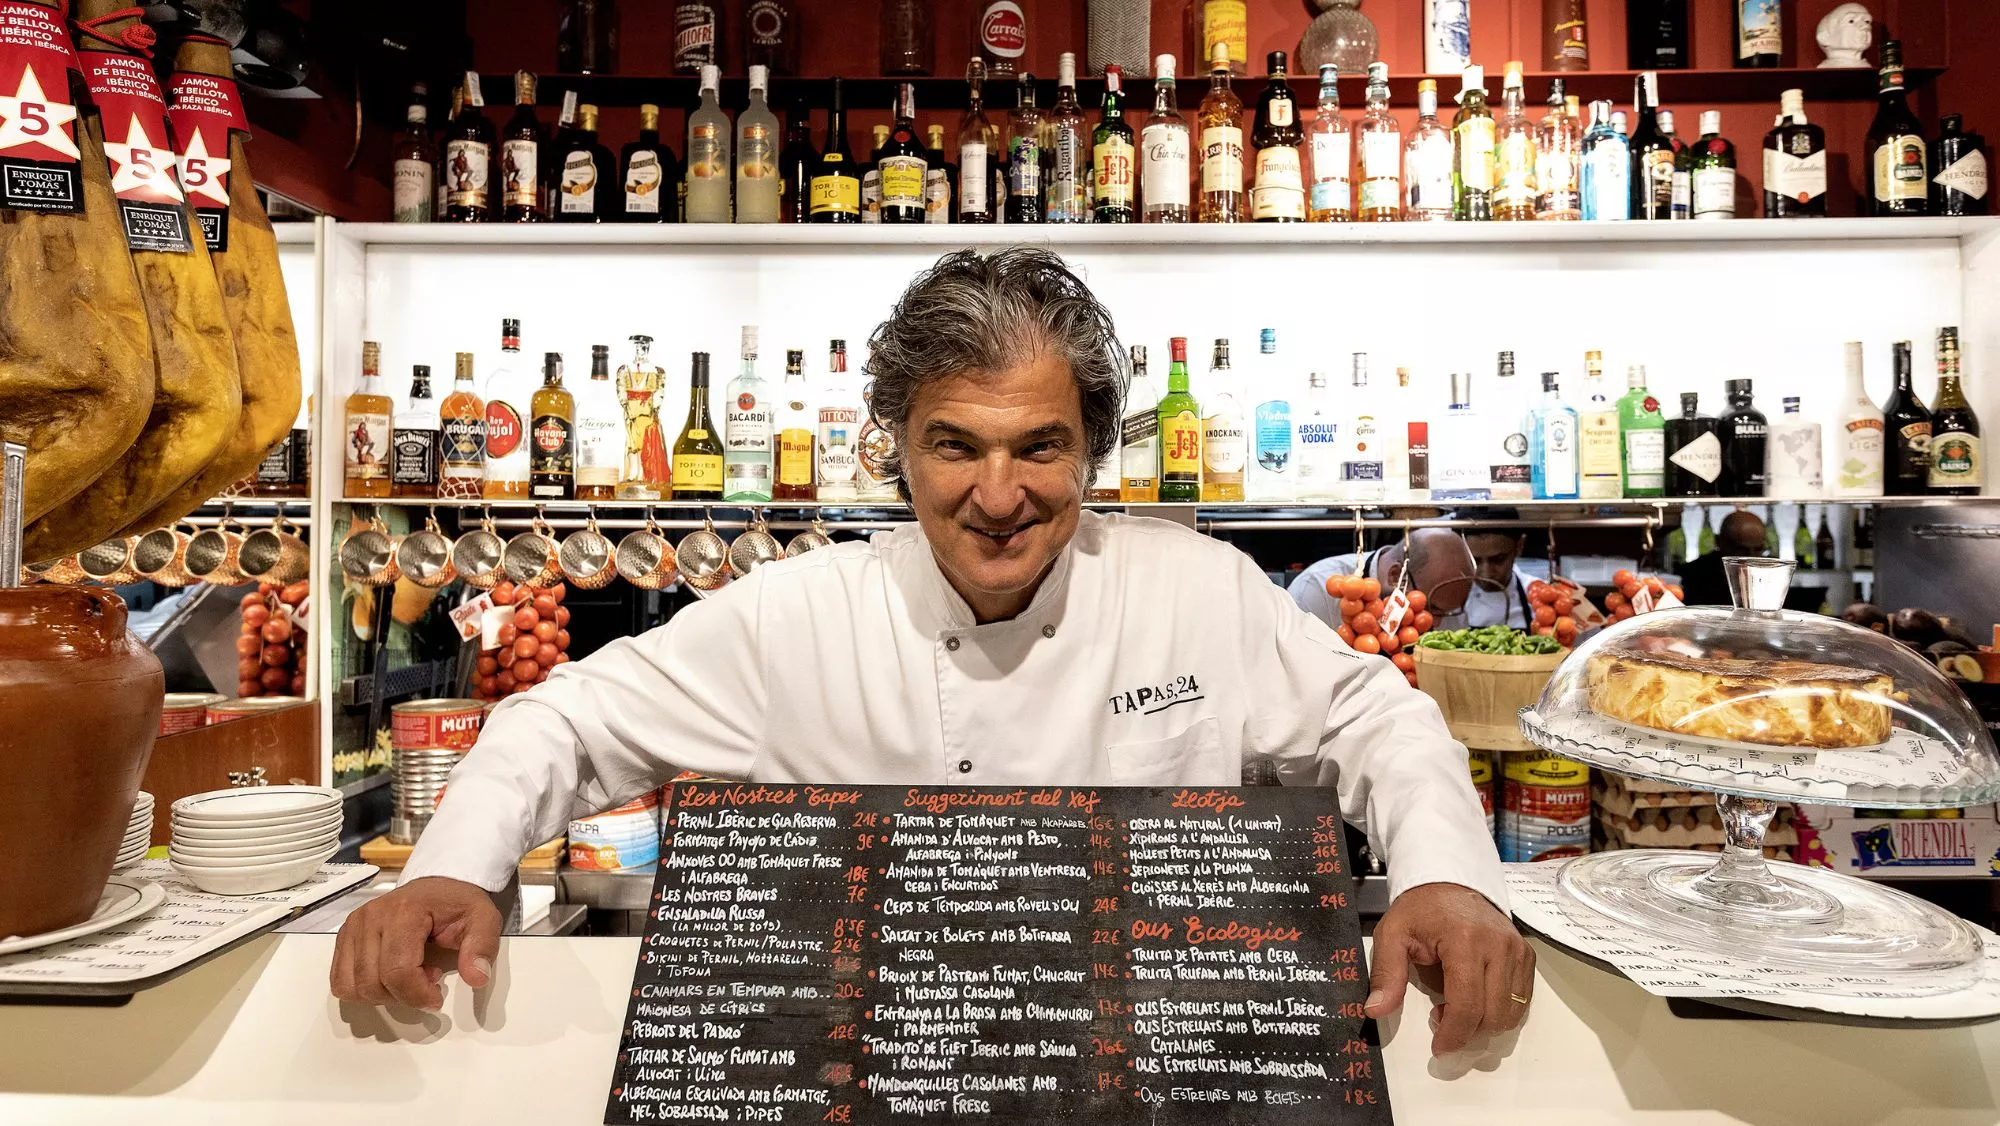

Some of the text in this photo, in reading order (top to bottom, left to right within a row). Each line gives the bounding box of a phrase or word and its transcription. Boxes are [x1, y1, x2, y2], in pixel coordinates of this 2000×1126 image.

[1, 6, 49, 20] JAMÓN
[1, 26, 52, 41] IBÉRICO
[9, 17, 63, 35] BELLOTA
[6, 37, 32, 45] RAZA
[35, 40, 70, 55] IBÉRICA
[104, 58, 145, 70] JAMÓN
[93, 68, 156, 84] DE BELLOTA
[106, 77, 150, 90] IBÉRICO
[181, 78, 219, 89] JAMÓN
[134, 90, 163, 103] IBÉRICA
[180, 96, 219, 106] IBÉRICO
[188, 88, 228, 100] BELLOTA
[20, 102, 50, 136] 5
[204, 106, 232, 117] IBÉRICA
[131, 149, 158, 179] 5
[12, 170, 64, 182] ENRIQUE
[184, 159, 208, 186] 5
[131, 212, 173, 223] ENRIQUE
[729, 411, 765, 422] BACARDÍ
[535, 428, 567, 437] Havana
[1299, 424, 1337, 433] ABSOLUT
[1170, 430, 1198, 459] J&B
[1302, 434, 1334, 443] VODKA
[545, 457, 553, 467] 7
[679, 785, 862, 810] Les Nostres Tapes
[903, 788, 1101, 814] Suggeriment del Xef
[794, 813, 836, 829] RESERVA
[852, 811, 878, 828] 21€
[893, 813, 934, 828] TARTAR
[1129, 814, 1335, 832] OSTRA NATURAL 5€
[1901, 822, 1968, 858] BUENDIA
[812, 854, 843, 868] FRESC
[905, 848, 962, 863] ALFABREGA
[1213, 861, 1342, 878] PLANXA 20€
[688, 872, 749, 885] ALFABREGA
[904, 879, 932, 893] CEBA
[662, 886, 778, 903] LES NOSTRES BRAVES
[1320, 893, 1348, 910] 24€
[729, 906, 765, 921] RUSSA
[883, 898, 914, 917] CEPS
[1091, 896, 1119, 915] 24€
[1091, 929, 1121, 945] 22€
[1131, 918, 1174, 941] Ous
[649, 933, 709, 948] CROQUETES
[899, 947, 935, 962] NEGRA
[1191, 947, 1237, 964] PATATES
[1267, 947, 1299, 964] CEBA
[667, 964, 711, 977] TOFONA
[1033, 964, 1087, 983] CHUCRUT
[963, 1002, 997, 1020] BRASA
[632, 1021, 676, 1039] PEBROTS
[678, 1024, 699, 1038] DEL
[1150, 1036, 1217, 1055] CATALANES
[627, 1047, 669, 1064] TARTAR
[636, 1067, 682, 1082] ALVOCAT
[952, 1093, 990, 1114] FRESC
[658, 1103, 729, 1121] SOBRASSADA
